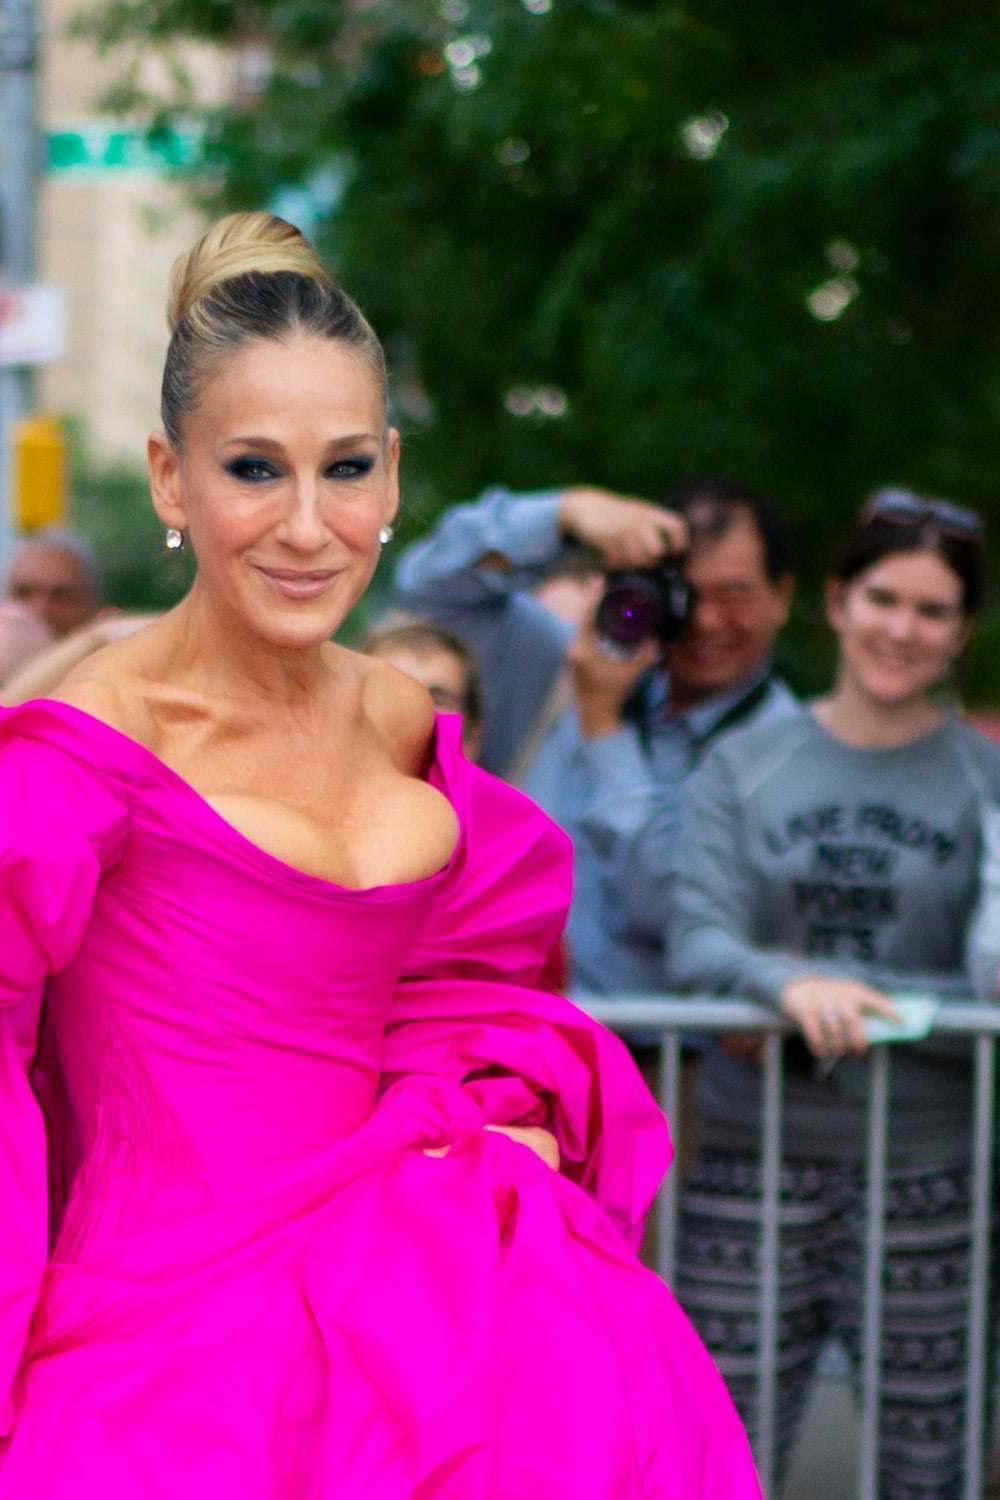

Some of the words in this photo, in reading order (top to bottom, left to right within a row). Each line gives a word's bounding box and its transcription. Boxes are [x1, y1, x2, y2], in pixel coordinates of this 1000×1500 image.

[762, 804, 843, 856] LIVE
[857, 803, 955, 863] FROM
[815, 845, 894, 877] NEW
[794, 881, 899, 917] YORK
